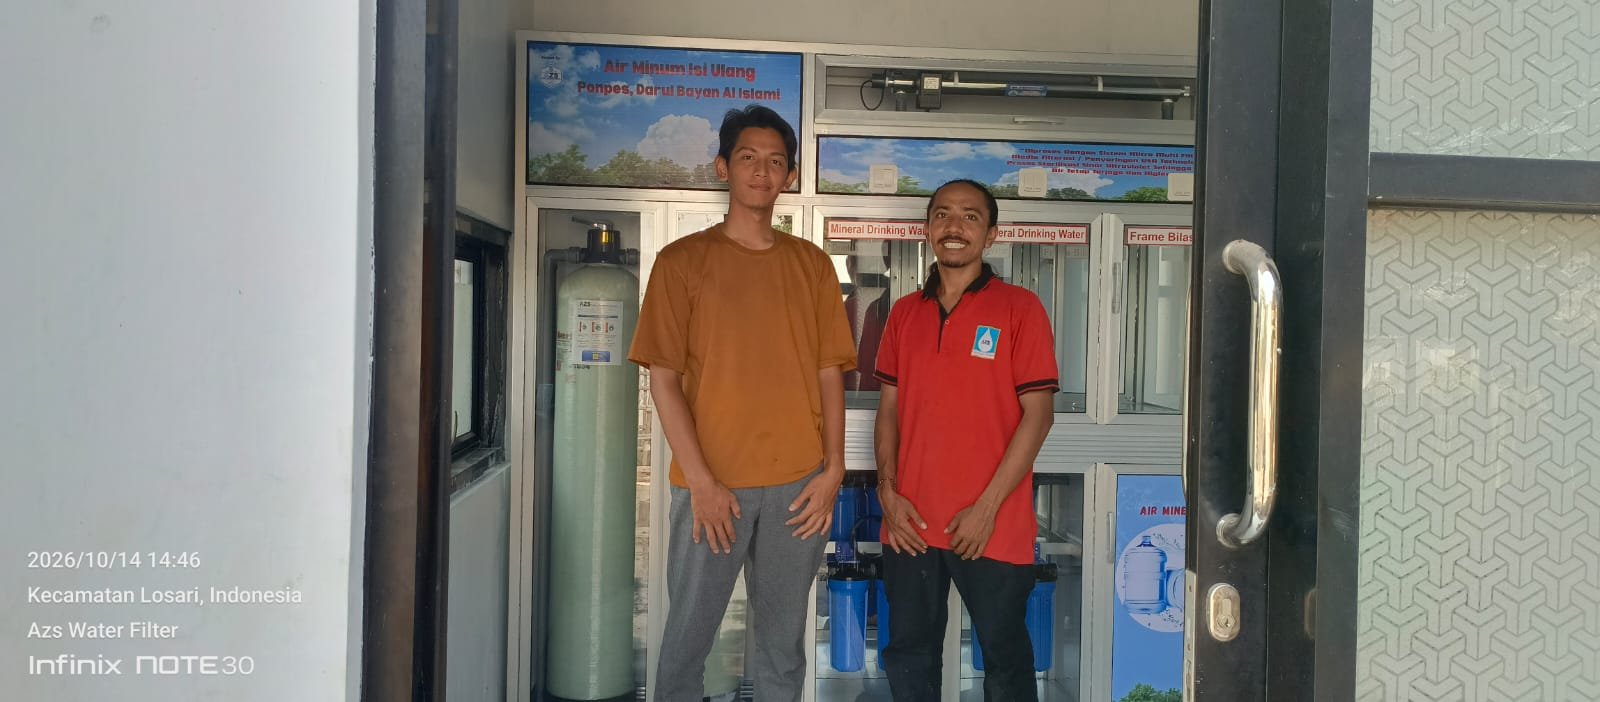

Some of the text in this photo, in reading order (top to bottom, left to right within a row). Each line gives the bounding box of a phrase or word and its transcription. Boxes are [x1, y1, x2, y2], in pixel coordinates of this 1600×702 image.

[603, 59, 756, 82] Air Minum Isi Ulang
[577, 80, 781, 100] Ponpes, Darul Bayan Al Islami
[830, 223, 865, 234] Mineral
[867, 225, 906, 237] Drinking
[998, 228, 1086, 241] eral Drinking Water
[1130, 231, 1193, 242] Frame Bilas
[1140, 505, 1186, 516] AIR MINE
